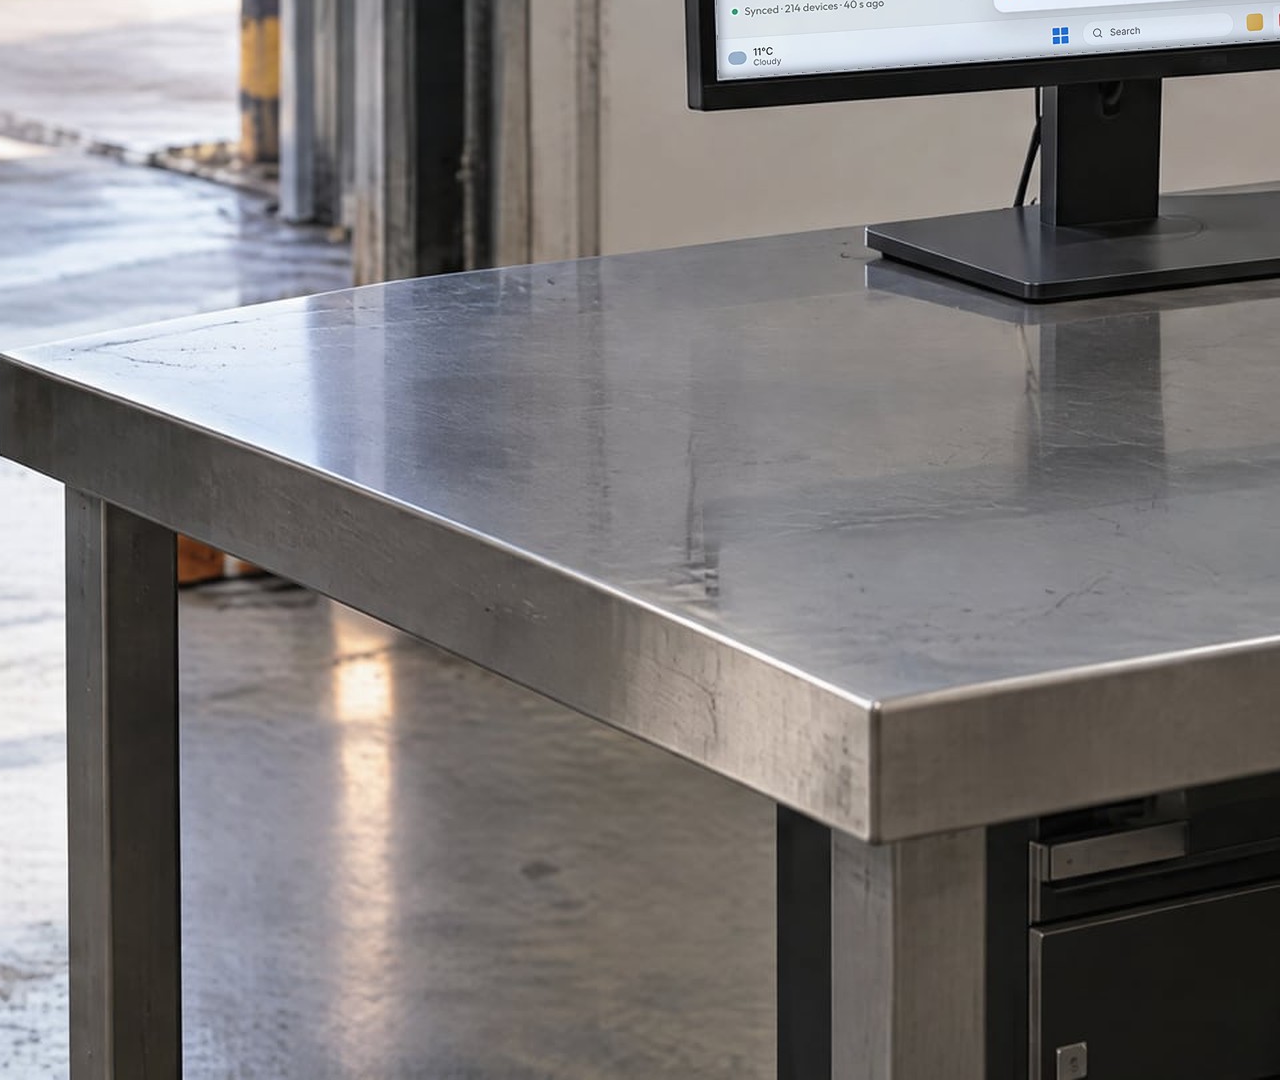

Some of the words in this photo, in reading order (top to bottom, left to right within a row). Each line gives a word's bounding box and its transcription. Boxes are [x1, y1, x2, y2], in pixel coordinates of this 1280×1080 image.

[745, 5, 779, 17] Synced
[785, 4, 801, 13] 214
[803, 2, 838, 12] devices
[844, 0, 857, 9] 40
[866, 0, 884, 10] ago
[1110, 27, 1140, 36] Search
[753, 58, 781, 66] Cloudy
